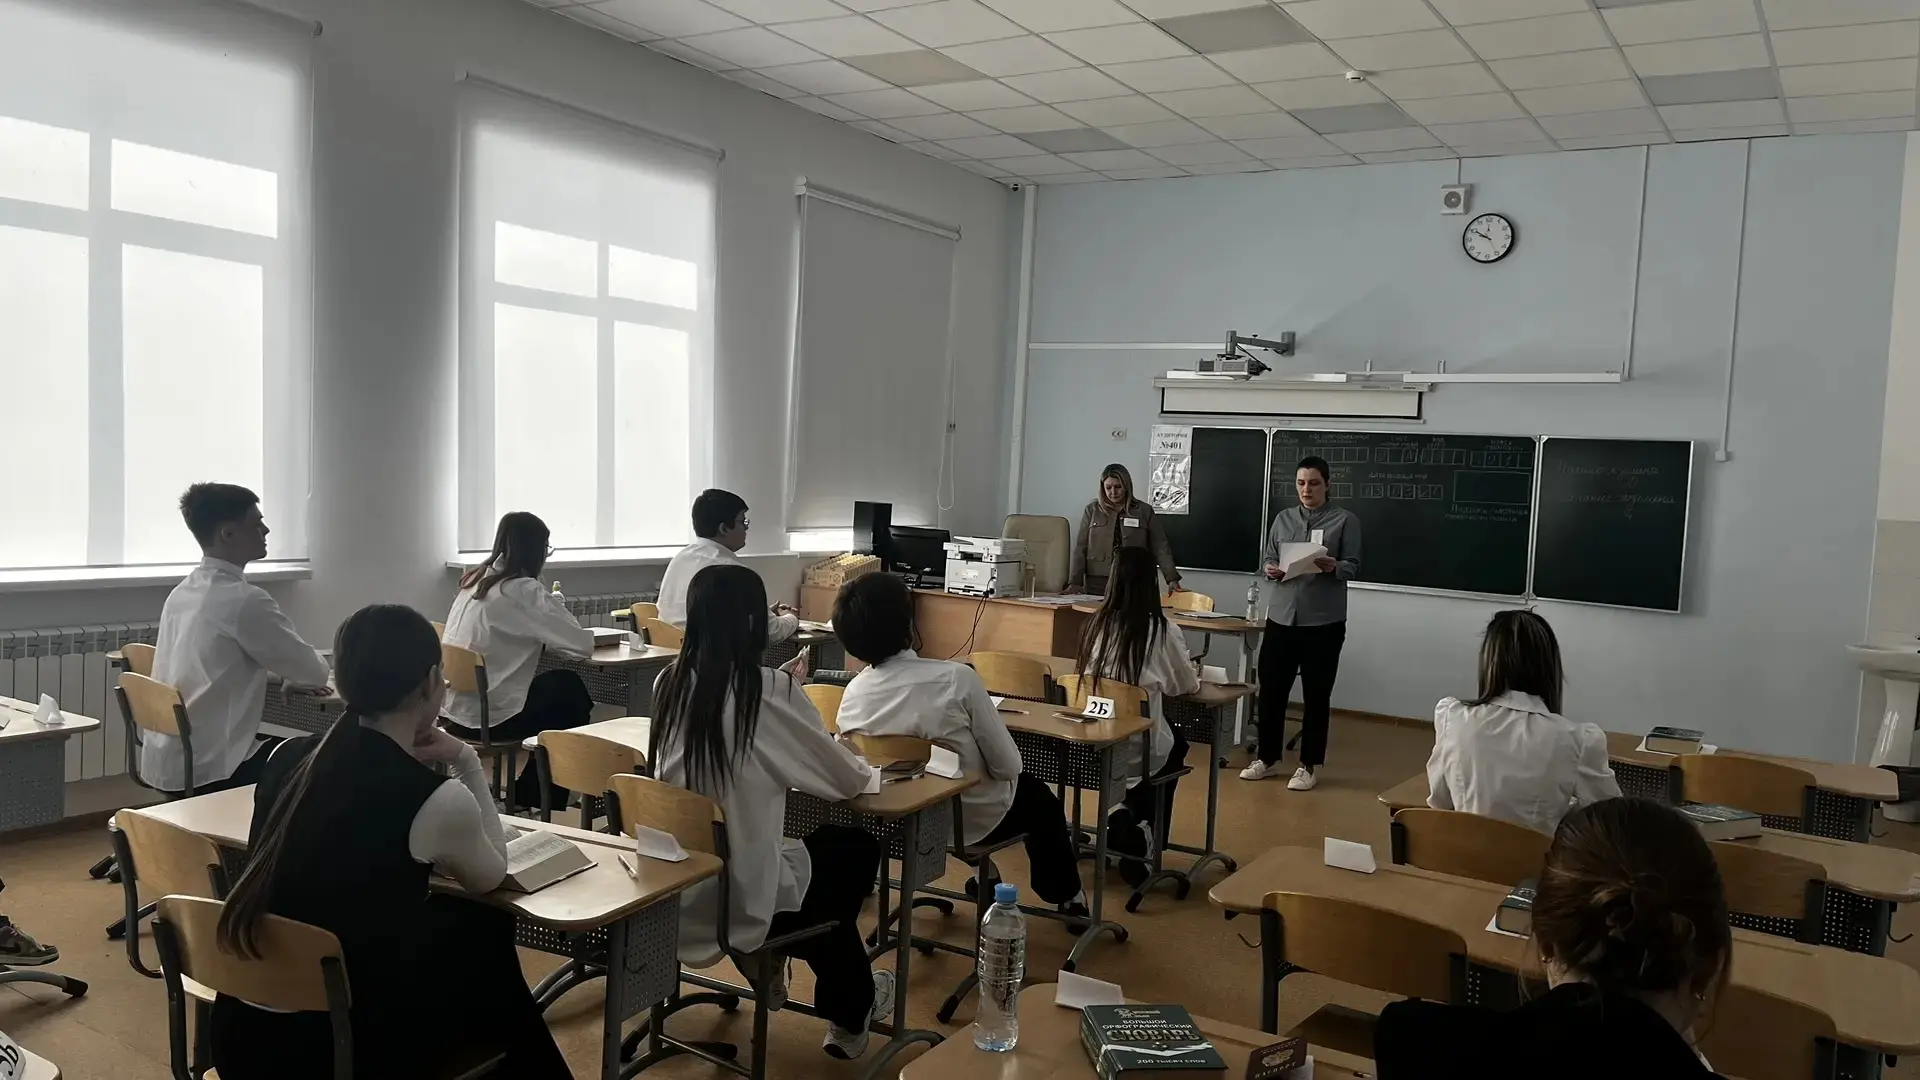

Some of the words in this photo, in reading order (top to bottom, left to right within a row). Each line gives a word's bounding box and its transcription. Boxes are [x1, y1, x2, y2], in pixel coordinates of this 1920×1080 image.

[1160, 441, 1183, 450] №401
[1088, 701, 1109, 715] 2Б
[1106, 1029, 1201, 1041] СЛОВАРЬ
